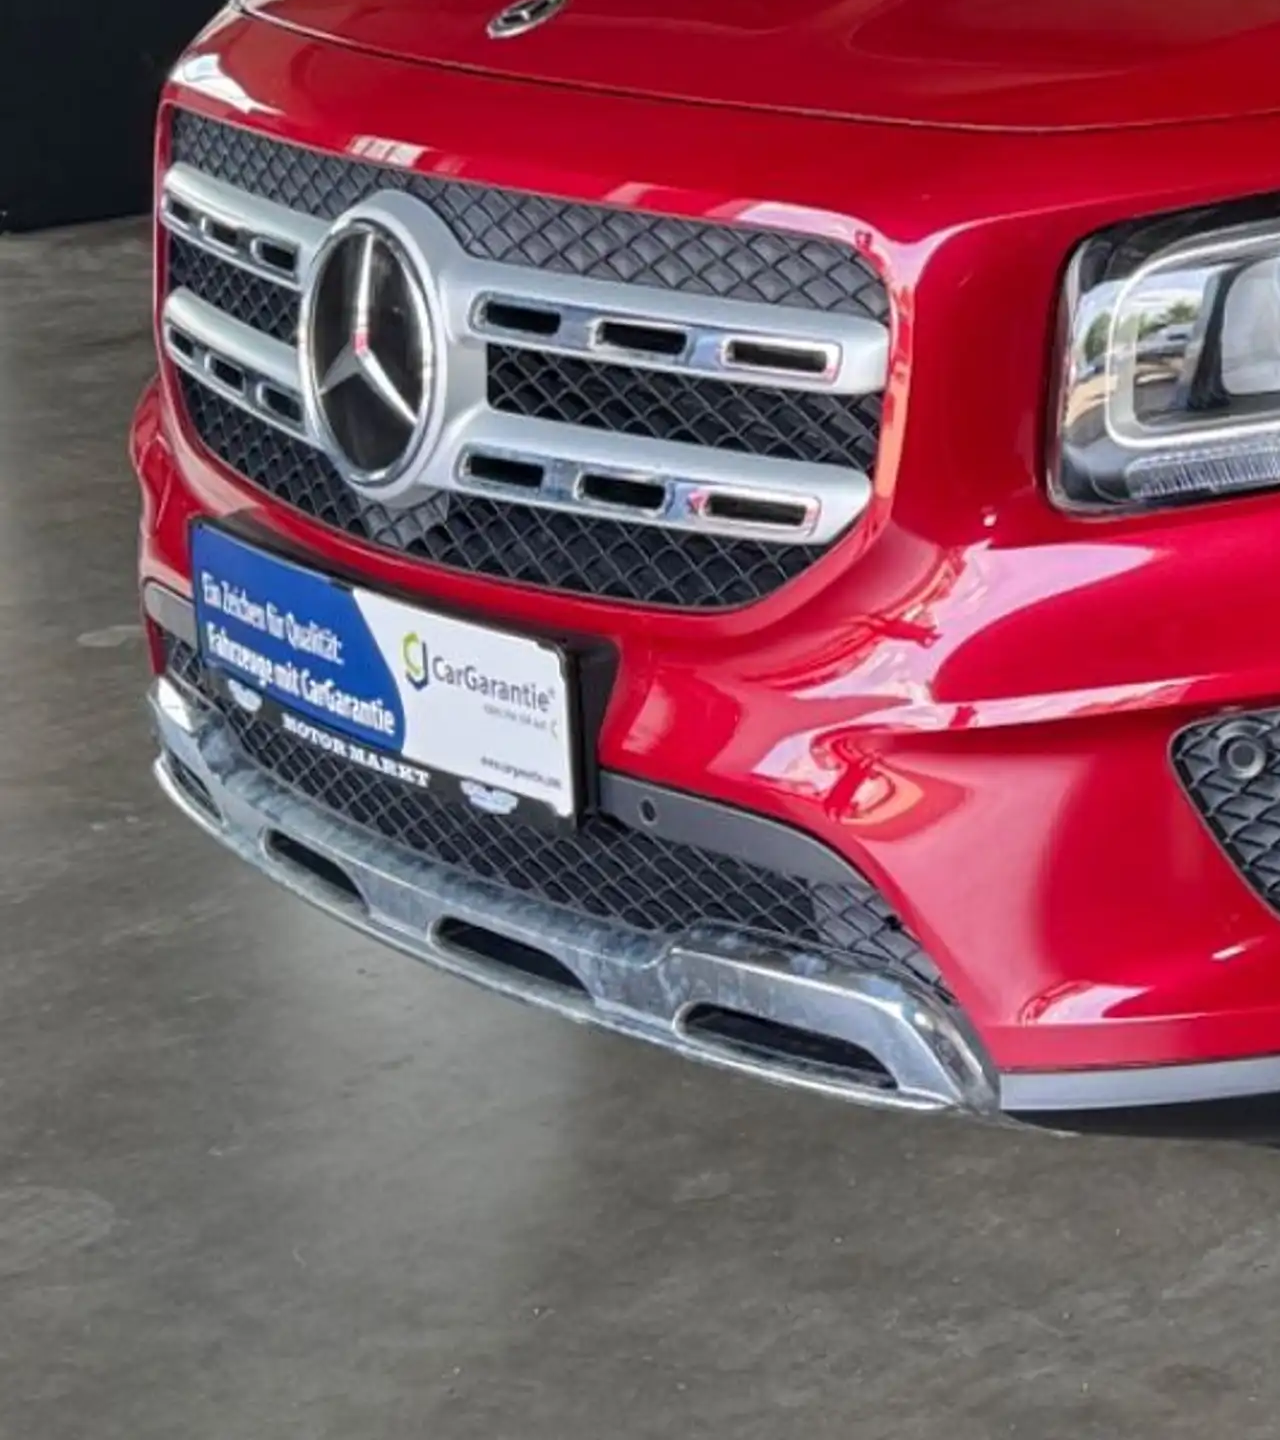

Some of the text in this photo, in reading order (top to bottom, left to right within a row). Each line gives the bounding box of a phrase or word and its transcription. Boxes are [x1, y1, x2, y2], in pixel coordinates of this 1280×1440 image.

[206, 621, 395, 737] Fahrzeuge mit CarGarantie
[281, 712, 347, 758] MOTOR
